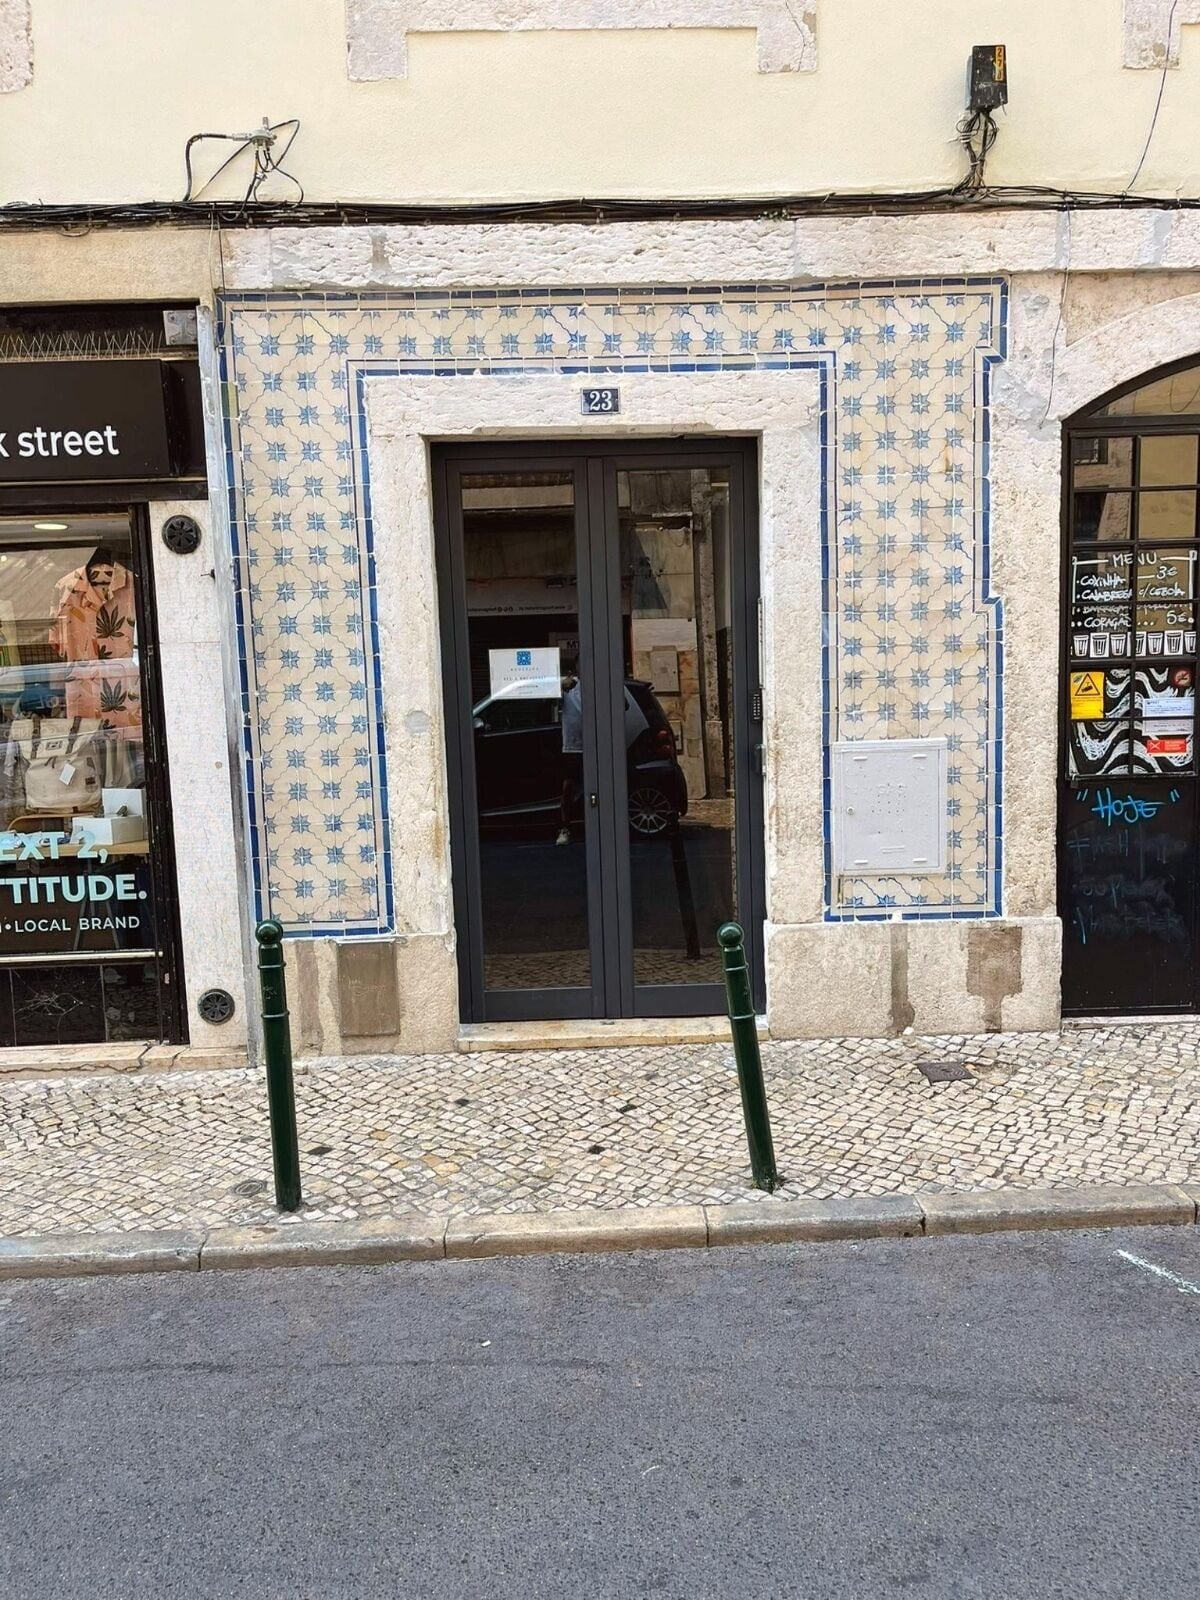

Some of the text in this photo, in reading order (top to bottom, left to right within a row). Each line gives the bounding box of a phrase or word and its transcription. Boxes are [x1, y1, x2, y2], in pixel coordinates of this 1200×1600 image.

[590, 390, 612, 411] 23
[17, 425, 120, 457] street
[1112, 551, 1157, 568] MENU
[1080, 573, 1126, 588] COXINHA
[77, 830, 109, 863] 2,
[0, 874, 148, 904] TITUDE.
[79, 916, 140, 930] BRAND
